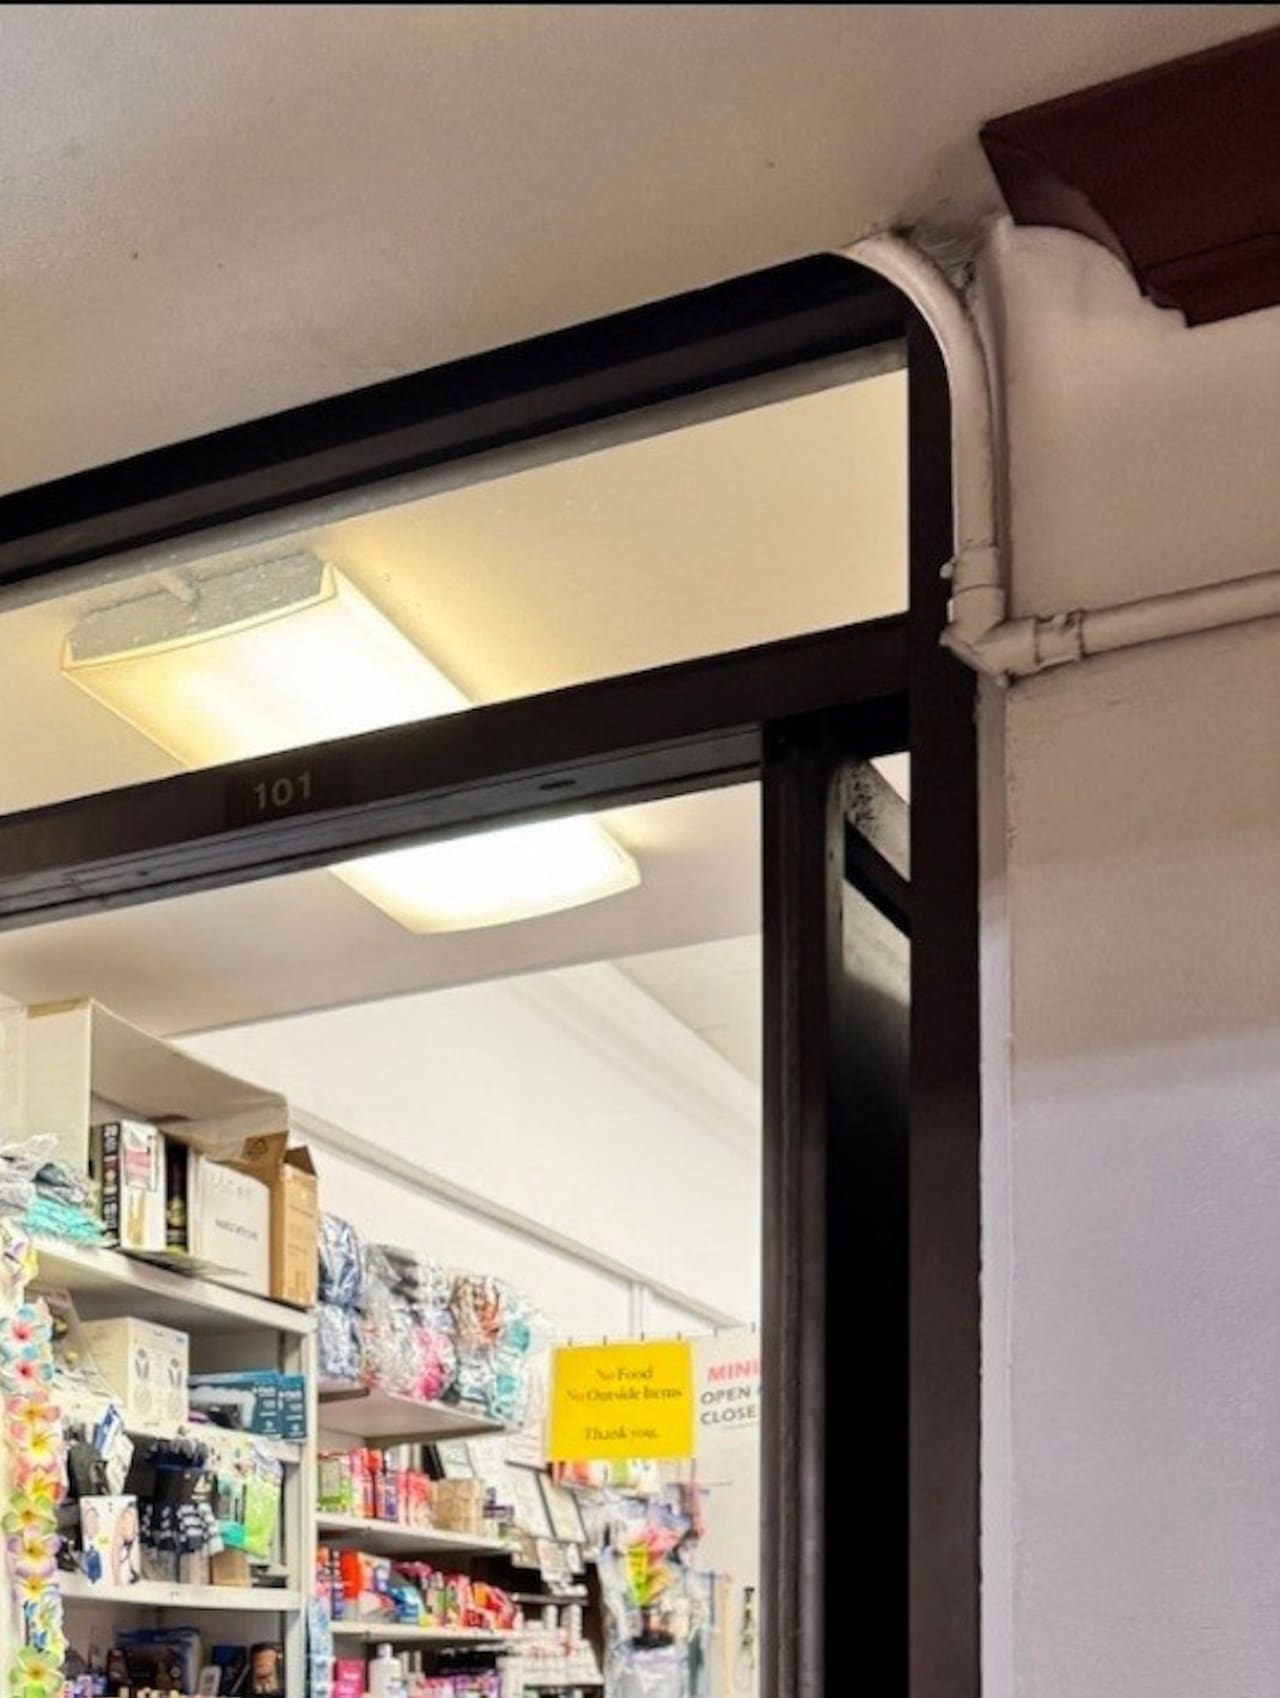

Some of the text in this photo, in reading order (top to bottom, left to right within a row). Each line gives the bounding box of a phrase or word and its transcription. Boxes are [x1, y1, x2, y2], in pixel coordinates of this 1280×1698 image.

[253, 770, 312, 810] 101
[617, 1366, 653, 1381] Food
[700, 1385, 751, 1406] OPEN
[584, 1426, 627, 1441] Thank
